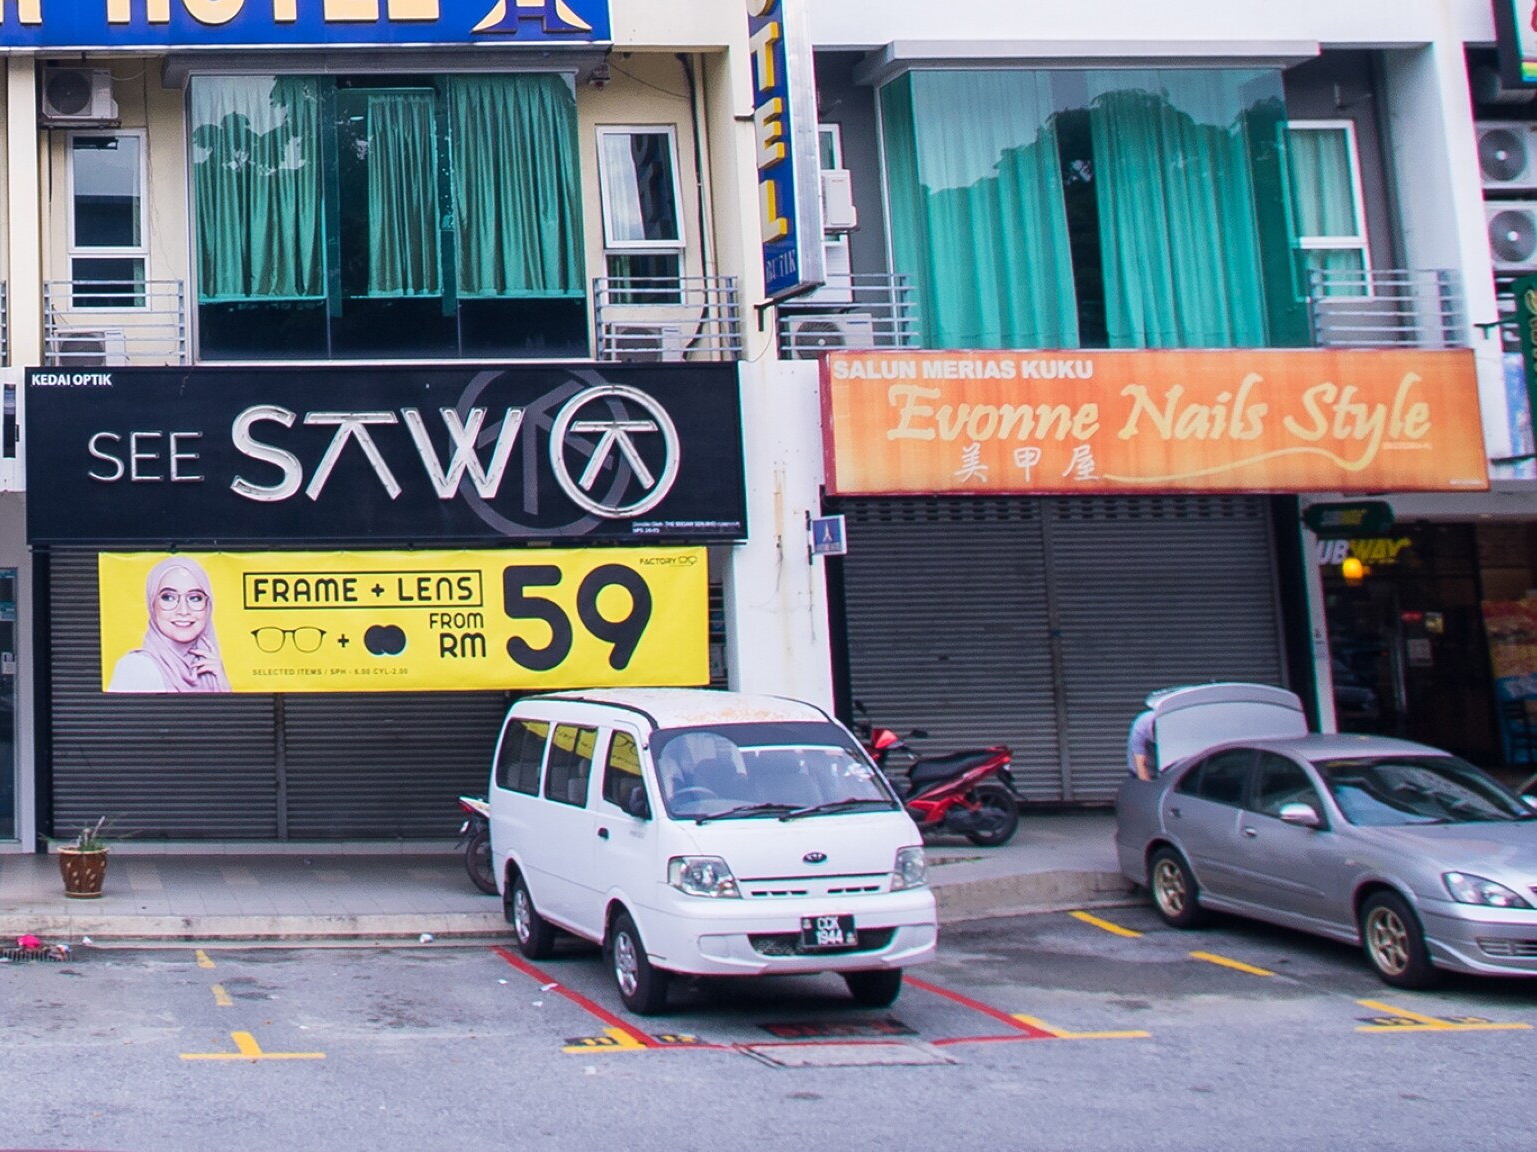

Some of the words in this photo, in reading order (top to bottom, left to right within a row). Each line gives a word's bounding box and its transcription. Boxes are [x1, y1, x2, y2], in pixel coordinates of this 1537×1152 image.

[31, 374, 70, 386] KEDAI
[72, 374, 112, 387] OPTIK
[833, 360, 917, 379] SALUN
[922, 360, 1017, 379] MERIAS
[1021, 359, 1094, 379] KUKU
[887, 384, 1100, 442] Evonne
[1117, 371, 1269, 441] Nails
[1283, 371, 1433, 471] Style
[87, 431, 205, 483] SEE
[954, 442, 1101, 483] 美甲屋
[1317, 536, 1412, 565] UBWAY
[253, 577, 359, 603] FRAME
[397, 576, 473, 601] LENS
[429, 612, 485, 629] FROM
[439, 632, 487, 658] RM
[503, 563, 653, 672] 59
[252, 668, 296, 676] SELECTED
[297, 668, 322, 676] ITEMS
